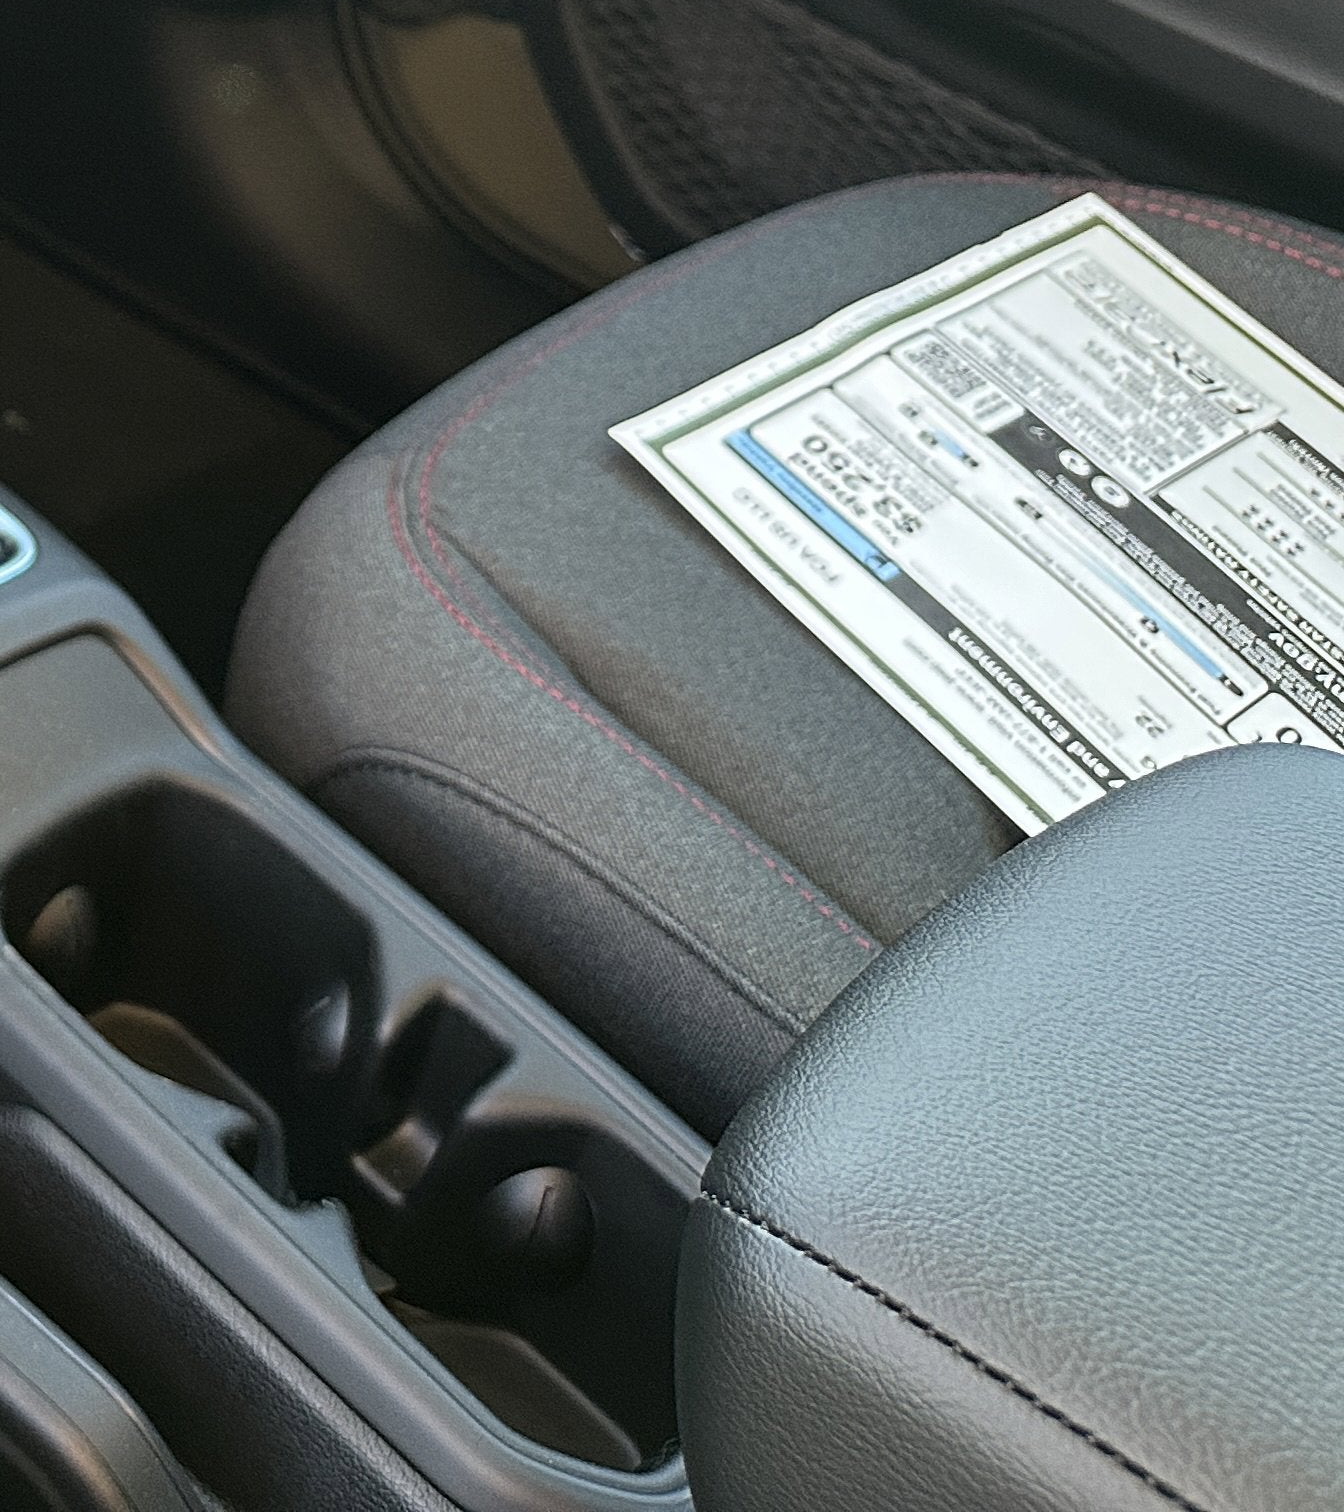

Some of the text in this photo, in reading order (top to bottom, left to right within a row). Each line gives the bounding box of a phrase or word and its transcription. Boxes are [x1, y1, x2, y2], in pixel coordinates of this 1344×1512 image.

[781, 449, 874, 522] spend
[795, 429, 931, 539] $3,250
[728, 485, 847, 588] FCA US LLC
[942, 625, 1074, 744] Environment
[1130, 709, 1166, 740] 22
[1063, 738, 1112, 781] and
